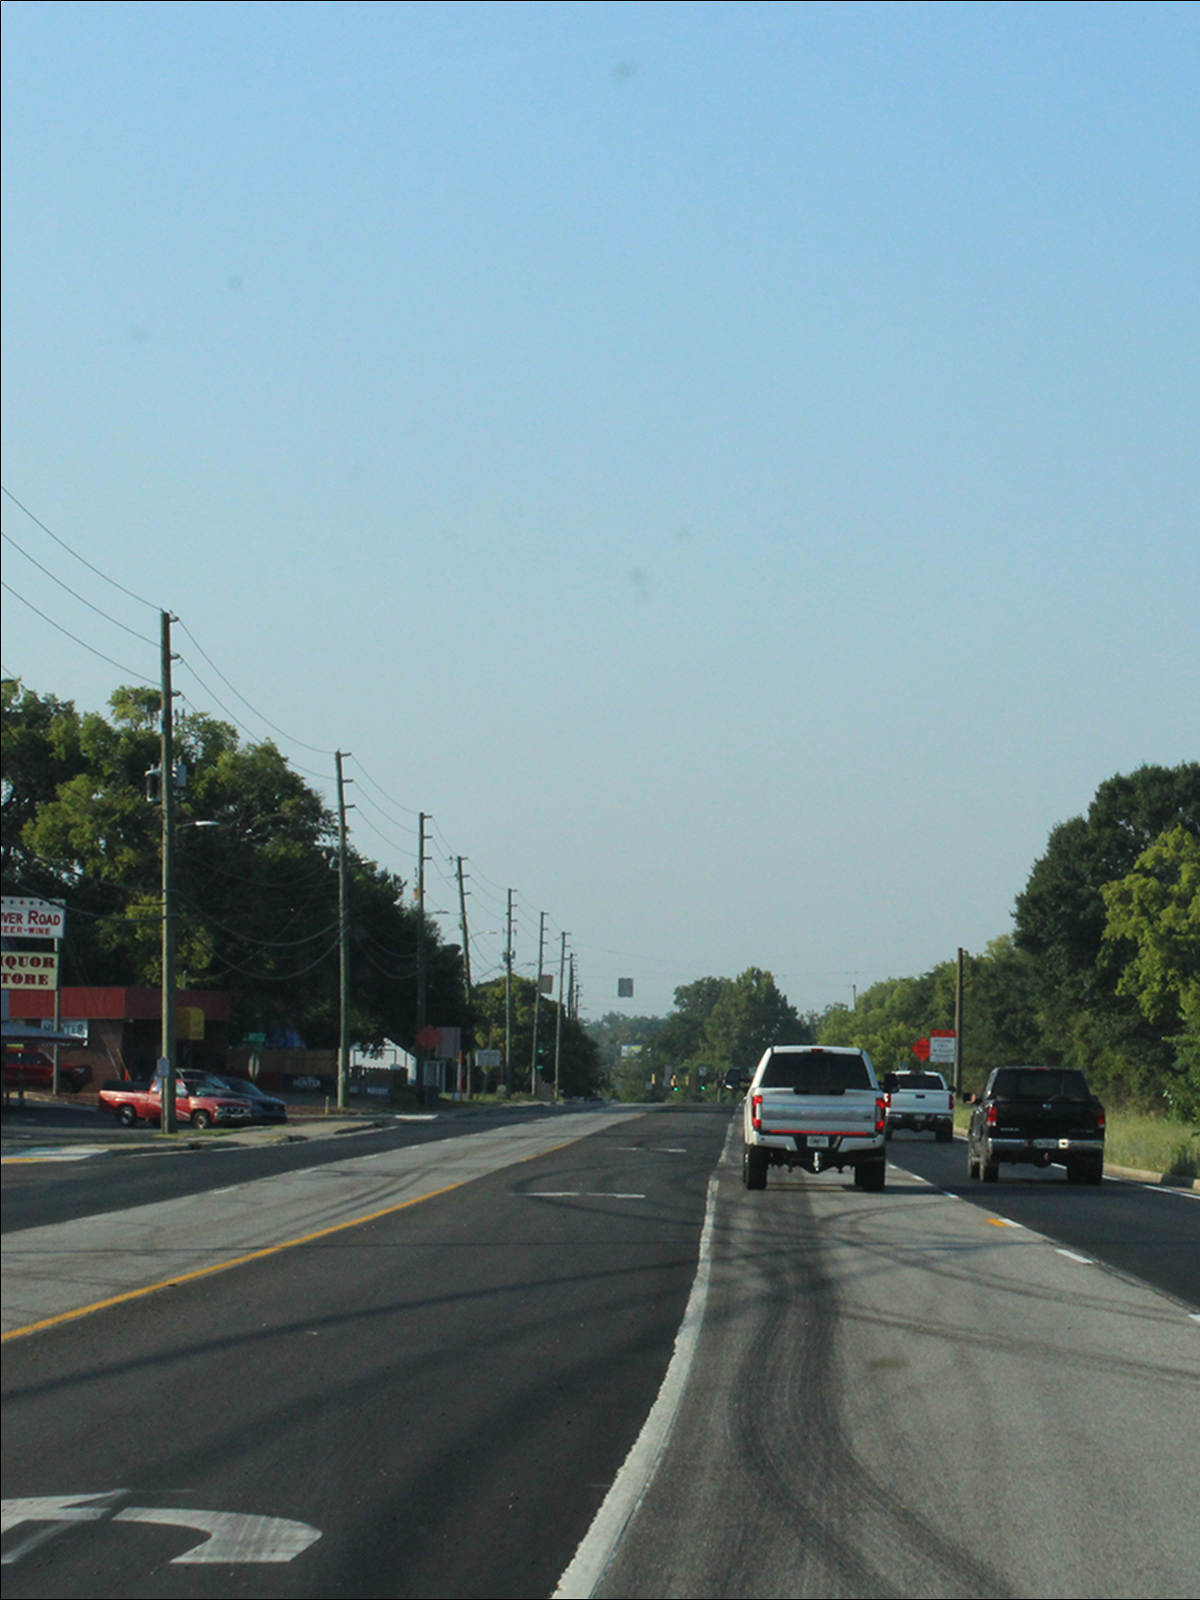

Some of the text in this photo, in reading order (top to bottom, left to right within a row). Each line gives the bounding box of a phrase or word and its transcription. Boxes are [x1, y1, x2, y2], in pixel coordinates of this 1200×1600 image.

[1, 910, 61, 927] VER ROAD
[1, 925, 51, 936] EER-WINE
